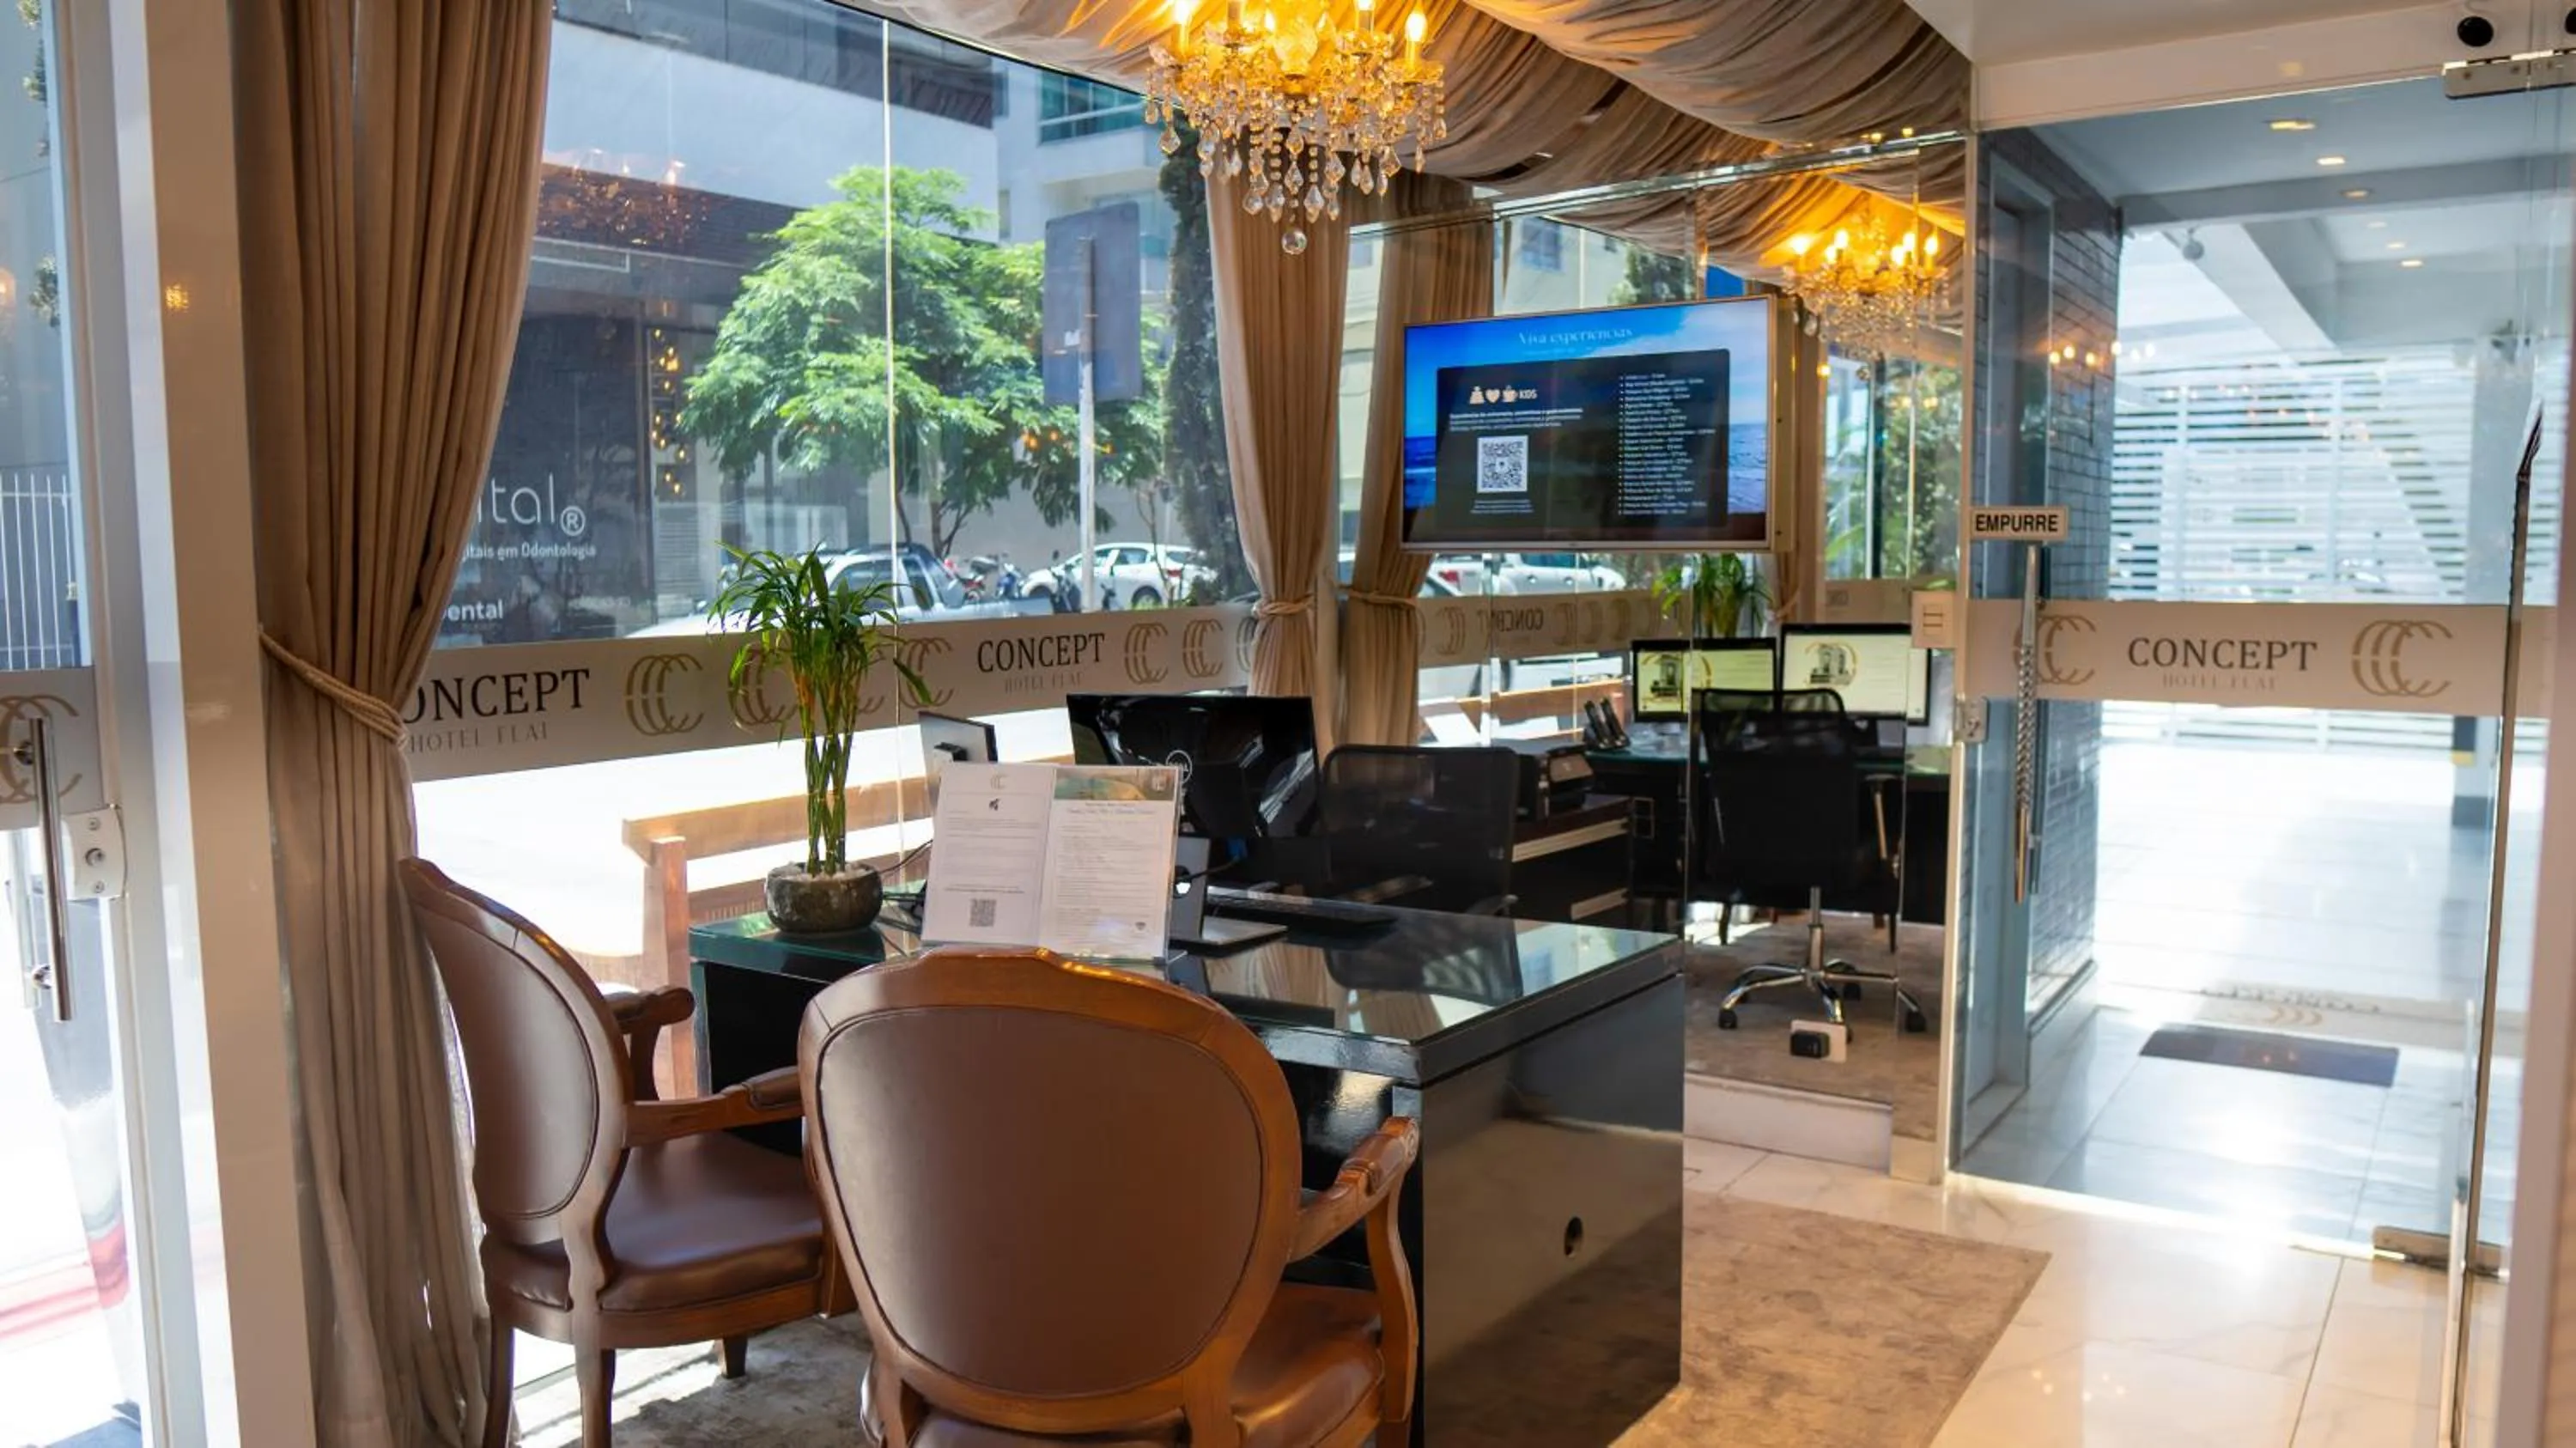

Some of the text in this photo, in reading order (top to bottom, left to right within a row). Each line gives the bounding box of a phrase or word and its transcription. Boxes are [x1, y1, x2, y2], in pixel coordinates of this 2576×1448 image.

[1976, 514, 2058, 532] EMPURRE
[498, 547, 519, 562] em
[521, 542, 597, 562] Odontologia
[443, 599, 503, 622] ental
[977, 632, 1105, 673] CONCEPT
[2128, 636, 2318, 672] CONCEPT
